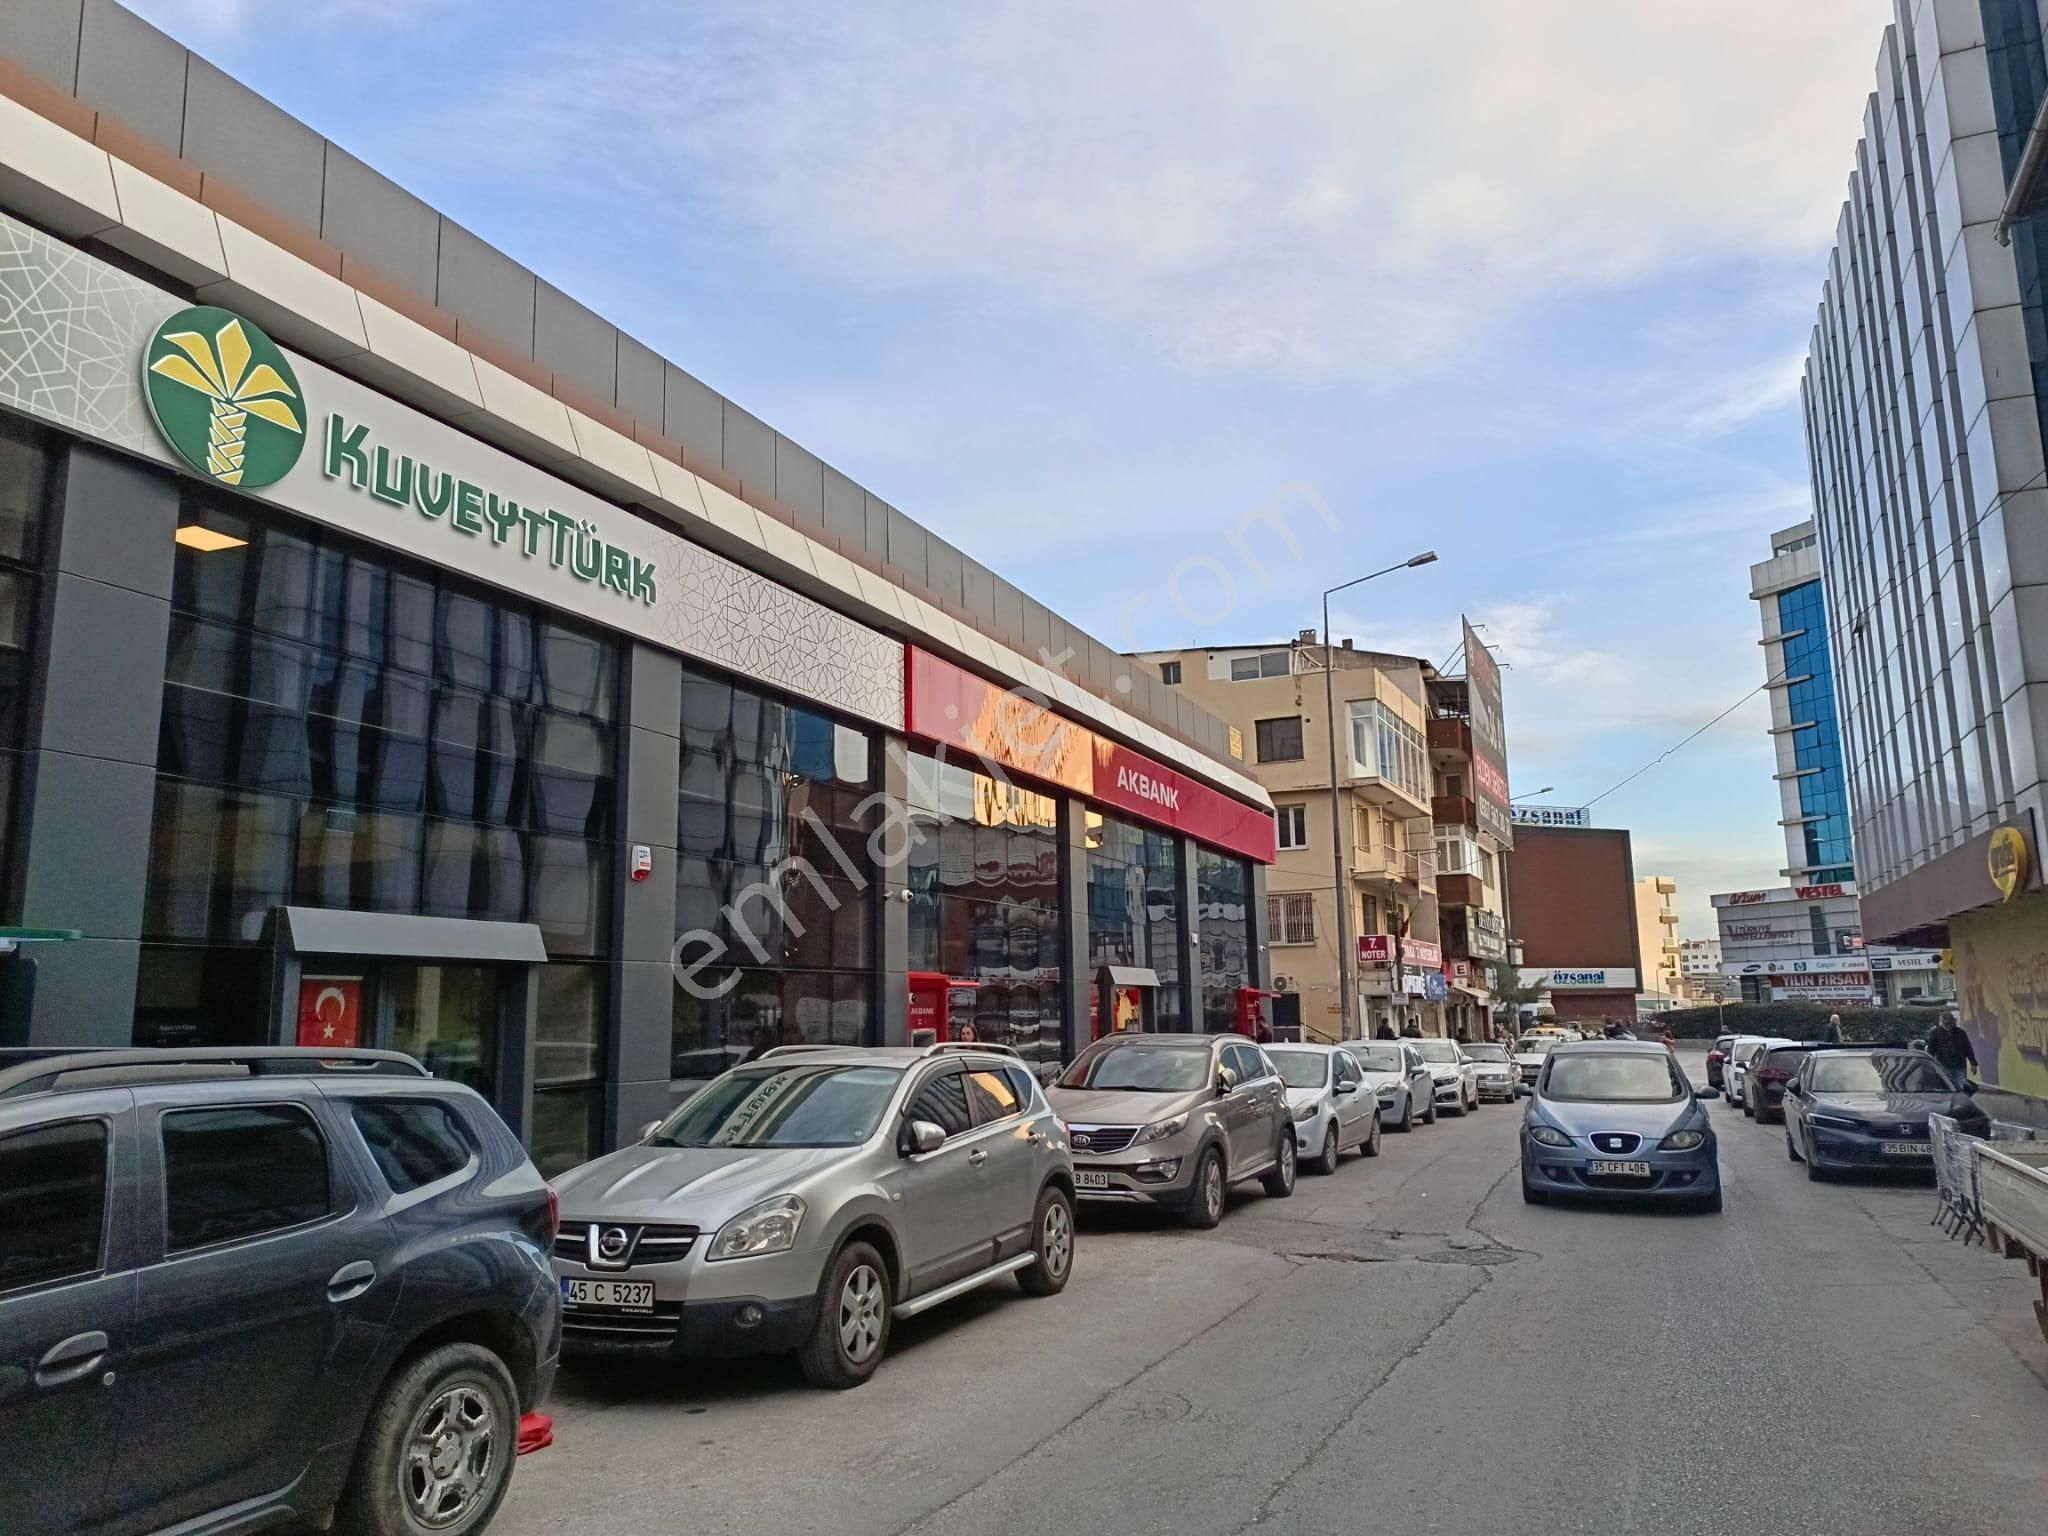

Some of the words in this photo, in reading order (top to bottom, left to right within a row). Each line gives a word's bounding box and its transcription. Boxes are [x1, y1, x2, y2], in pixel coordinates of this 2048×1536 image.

[1117, 766, 1180, 811] AKBANK
[1795, 884, 1846, 898] VESTEL
[1361, 949, 1386, 960] NOTER
[1553, 970, 1605, 986] özşanal
[1782, 975, 1814, 987] YILIN
[910, 1007, 934, 1015] AKBANK
[1886, 1144, 1897, 1153] 35
[1594, 1161, 1605, 1172] 35
[1608, 1162, 1626, 1173] CFT
[1629, 1163, 1646, 1173] 406
[1084, 1173, 1106, 1185] 8403
[569, 1282, 587, 1301] 45
[594, 1284, 605, 1302] C
[613, 1284, 651, 1304] 5237
